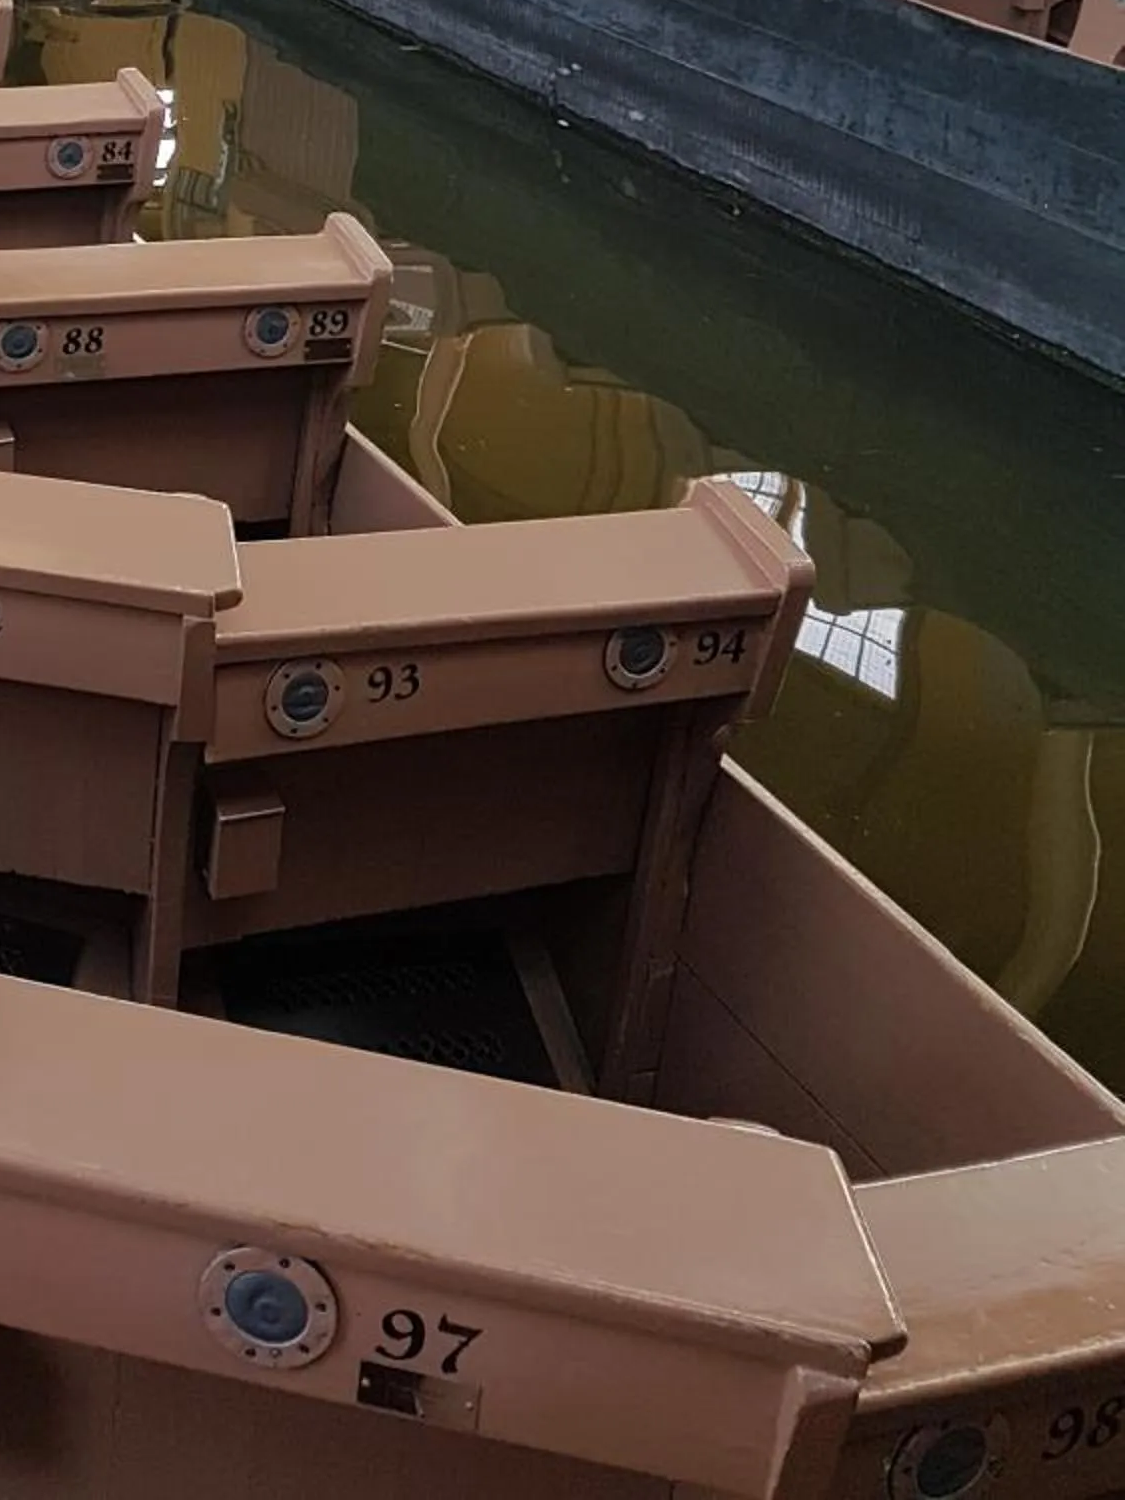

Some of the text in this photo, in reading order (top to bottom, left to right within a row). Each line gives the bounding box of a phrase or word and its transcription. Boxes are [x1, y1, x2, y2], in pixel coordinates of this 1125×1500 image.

[101, 139, 133, 163] 84
[61, 326, 106, 355] 88
[308, 309, 351, 337] 89
[692, 629, 747, 667] 94
[366, 663, 422, 704] 93
[374, 1309, 485, 1375] 97
[1040, 1395, 1125, 1461] 98
